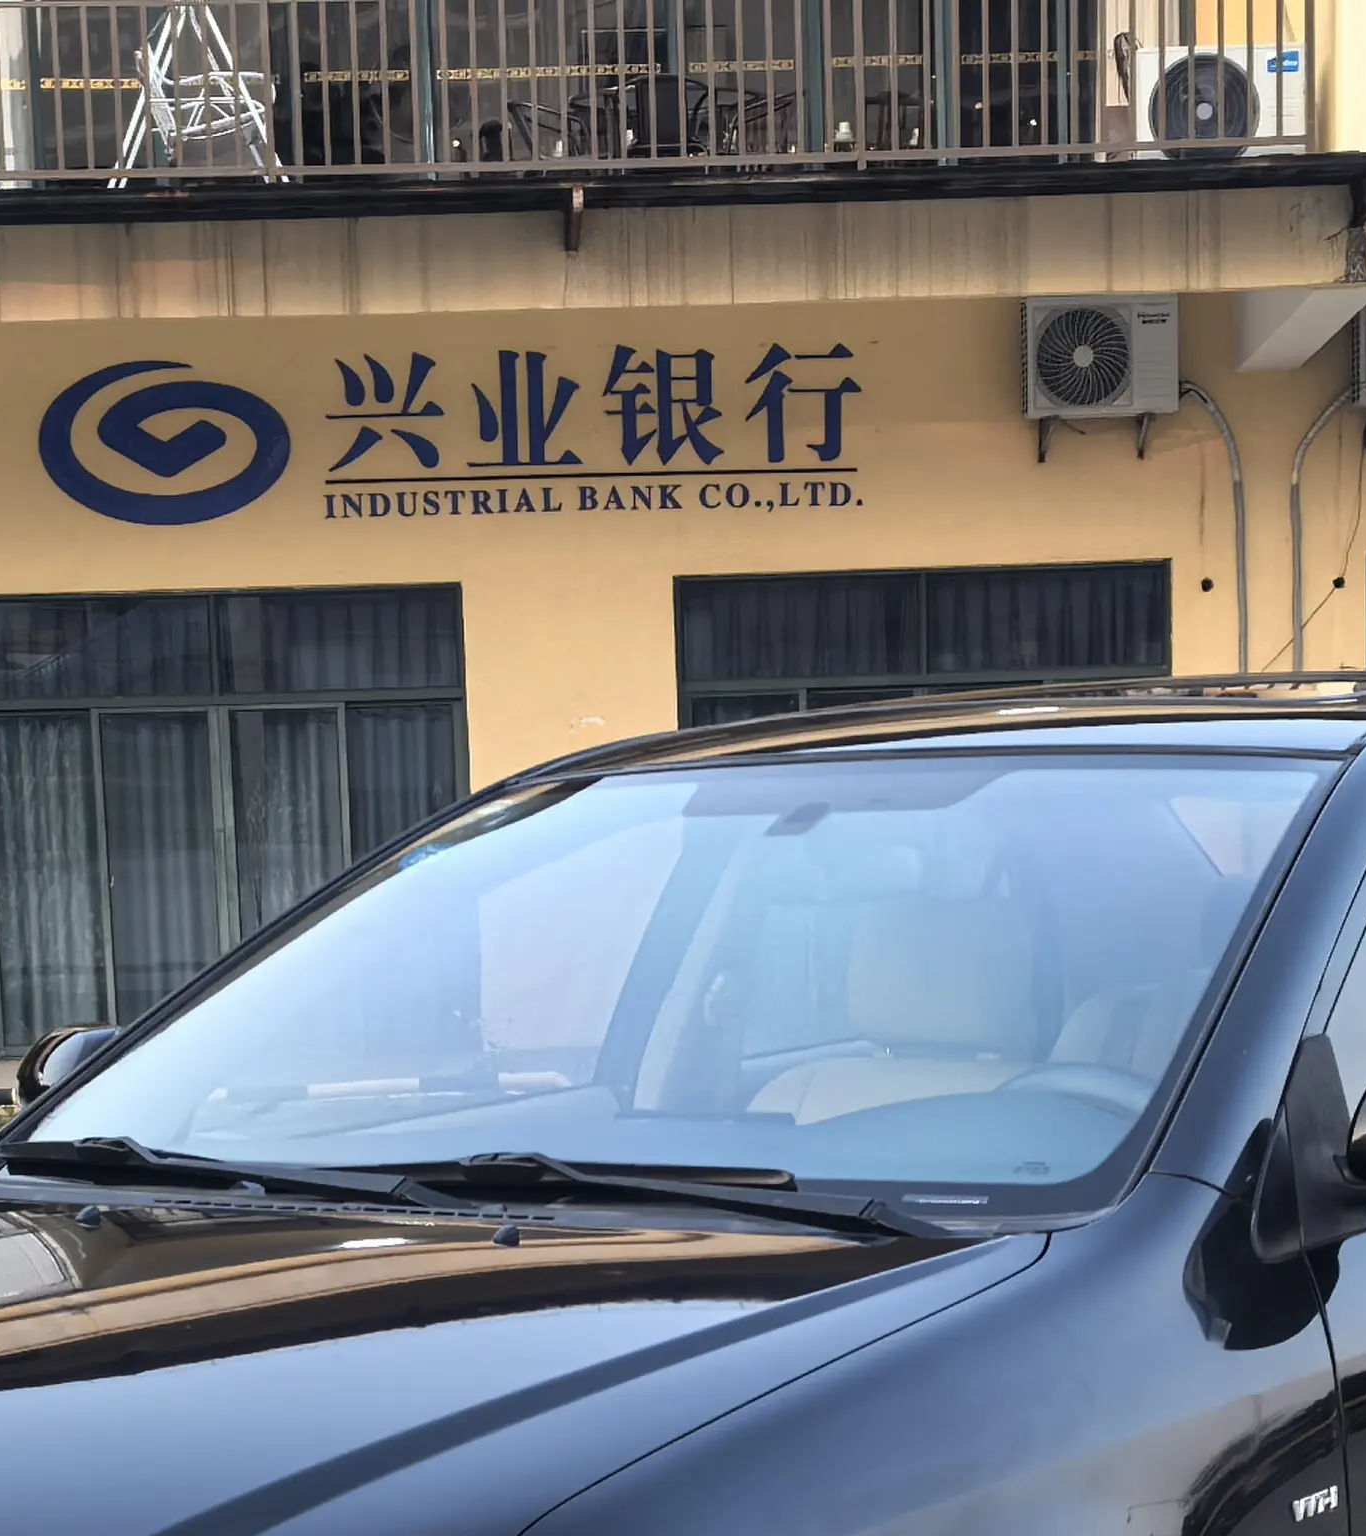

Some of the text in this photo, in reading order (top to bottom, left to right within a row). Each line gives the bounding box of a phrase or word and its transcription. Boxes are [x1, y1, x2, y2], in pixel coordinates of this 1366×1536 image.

[324, 342, 863, 472] 兴业银行
[324, 486, 563, 519] INDUSTRIAL
[578, 483, 683, 511] BANK
